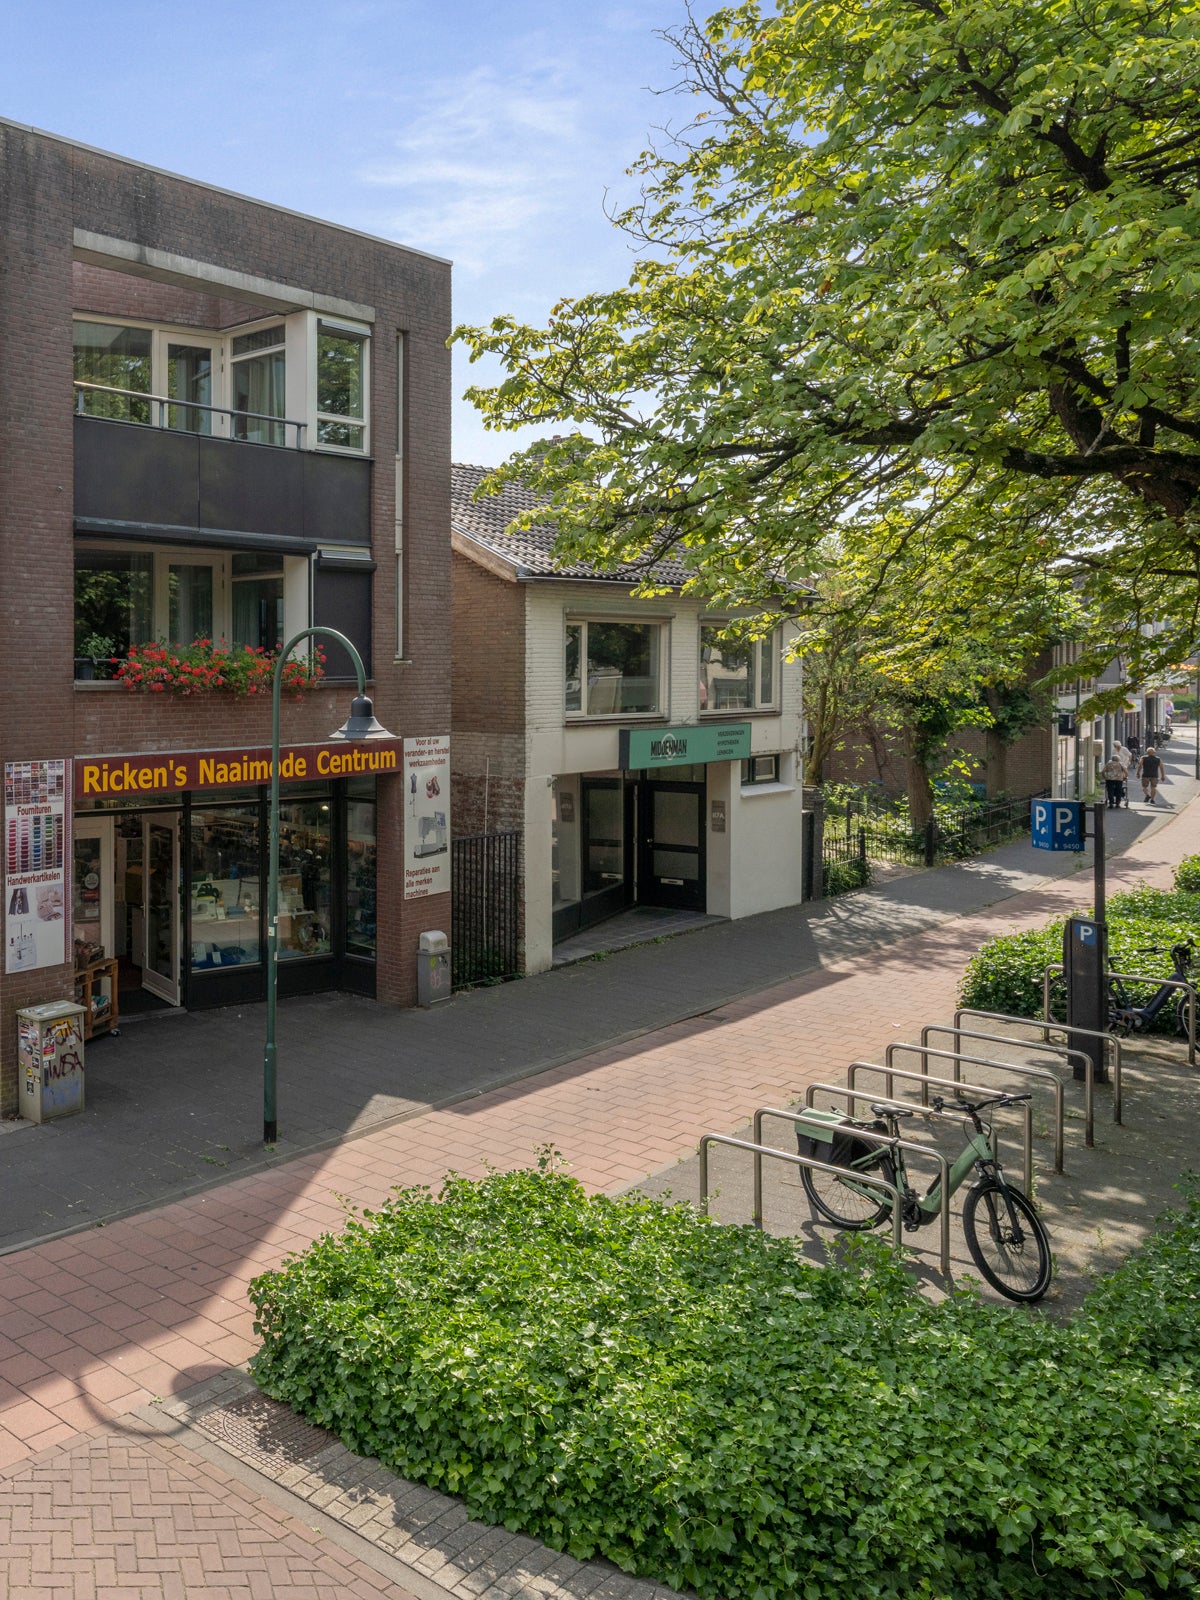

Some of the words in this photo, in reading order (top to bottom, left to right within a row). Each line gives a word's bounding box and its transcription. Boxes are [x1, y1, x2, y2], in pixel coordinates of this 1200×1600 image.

[416, 738, 426, 746] Voor
[83, 760, 187, 793] Ricken's
[316, 749, 396, 775] Centrum
[17, 804, 52, 815] Fournituren
[1035, 806, 1047, 830] P
[1055, 808, 1072, 832] P
[7, 872, 60, 886] Handwerkartikelen
[1080, 926, 1093, 941] P
